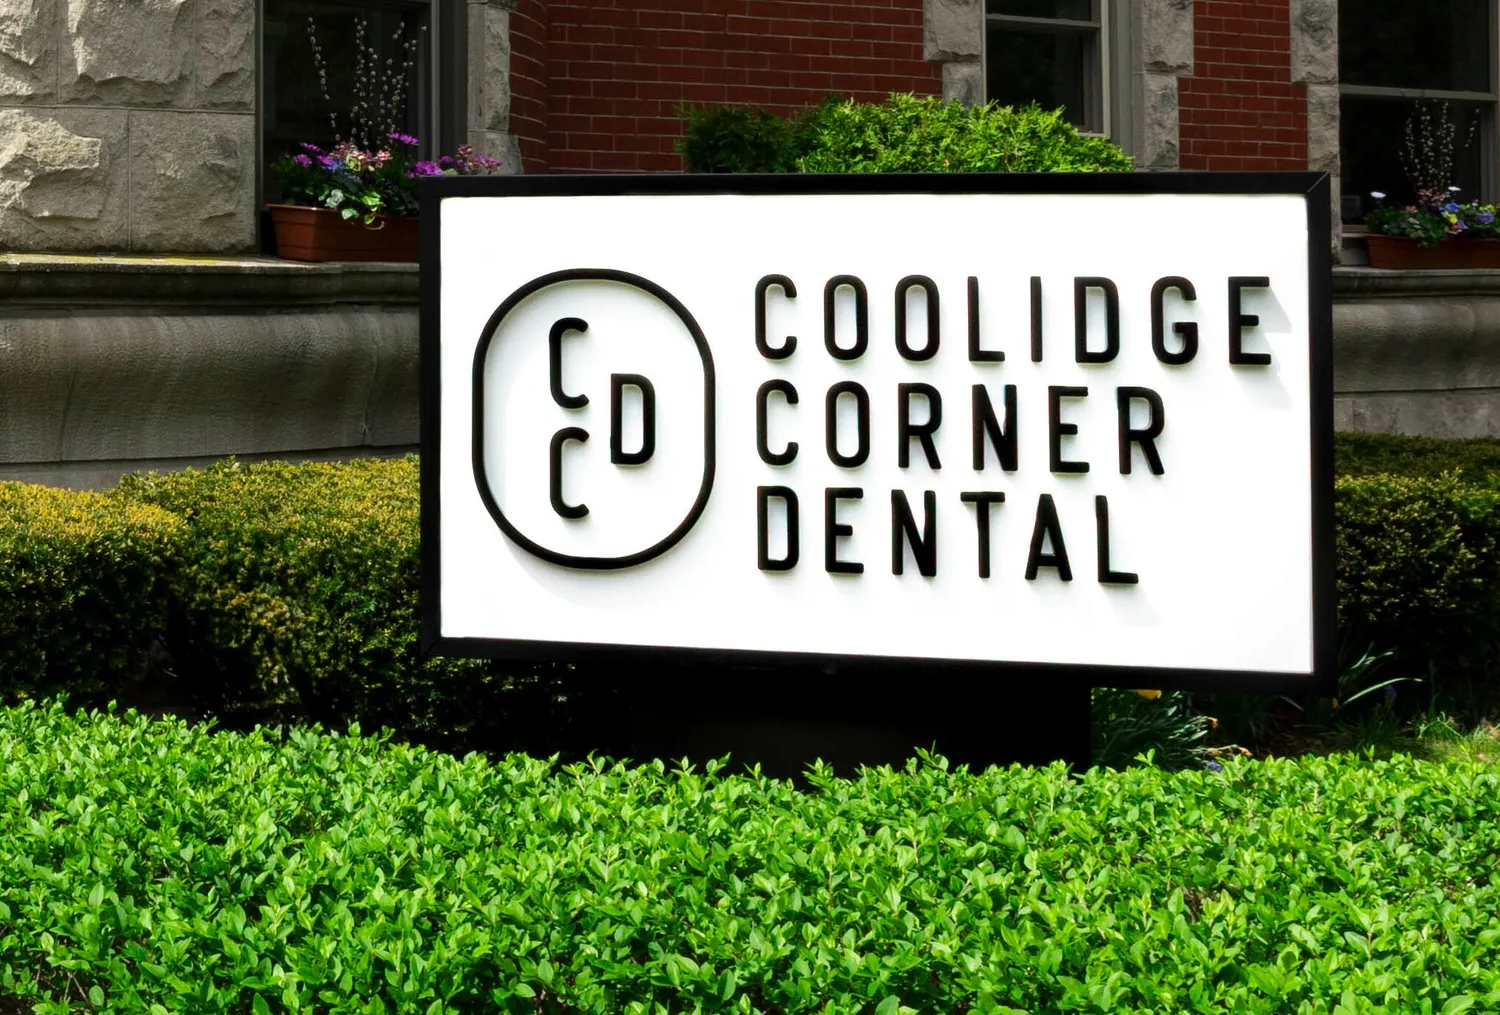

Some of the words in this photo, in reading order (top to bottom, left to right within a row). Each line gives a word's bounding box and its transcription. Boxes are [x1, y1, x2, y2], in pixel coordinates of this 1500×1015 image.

[754, 273, 1271, 366] COOLIDGE
[755, 379, 1166, 475] CORNER
[757, 486, 1140, 584] DENTAL
